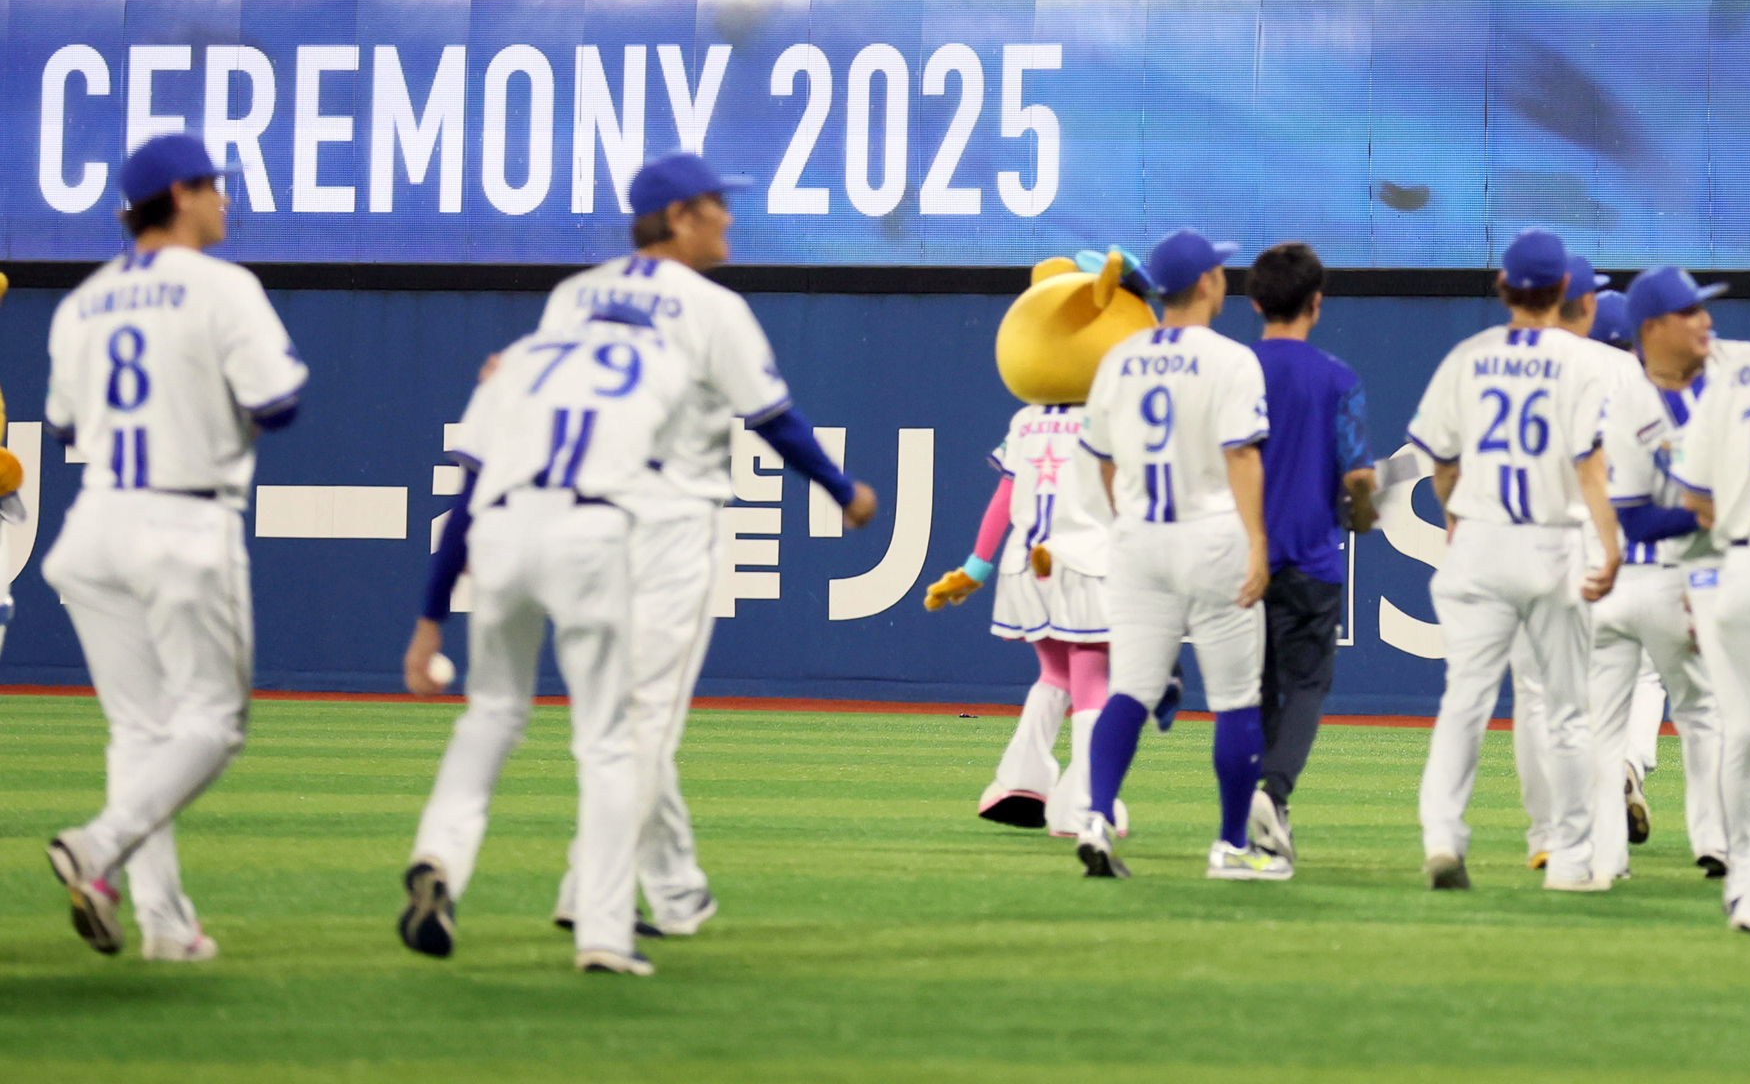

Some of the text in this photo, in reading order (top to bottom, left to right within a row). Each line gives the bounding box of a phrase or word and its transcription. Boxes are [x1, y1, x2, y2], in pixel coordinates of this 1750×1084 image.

[38, 43, 1064, 217] CEREMONY 2025
[105, 325, 150, 411] 8
[526, 339, 645, 398] 79
[1120, 354, 1200, 377] KYODA
[1473, 356, 1562, 383] MIMORI
[1140, 385, 1174, 453] 9
[1478, 387, 1551, 457] 26
